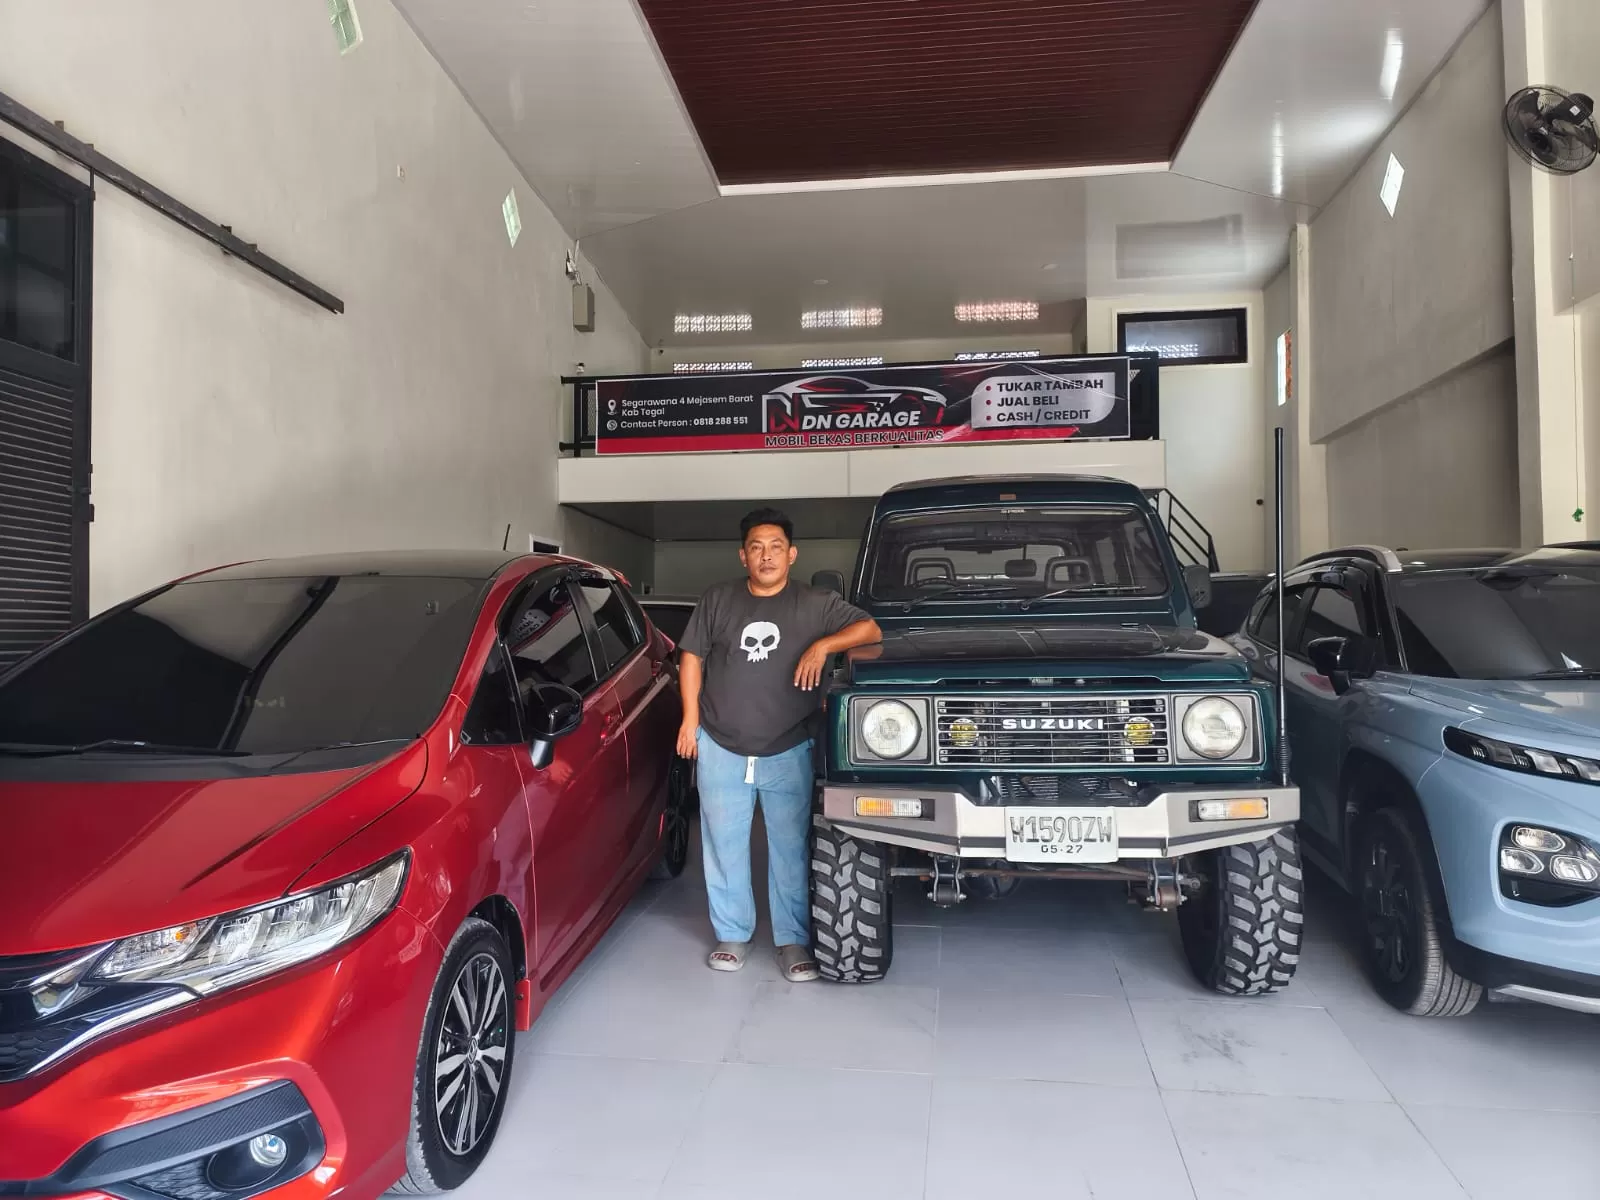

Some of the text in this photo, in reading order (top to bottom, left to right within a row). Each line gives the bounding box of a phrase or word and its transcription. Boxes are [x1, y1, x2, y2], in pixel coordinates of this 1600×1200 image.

[997, 379, 1103, 392] TUKAR TAMBAH
[621, 399, 678, 408] Segarawana
[679, 397, 685, 405] 4
[728, 394, 754, 403] Barat
[997, 395, 1059, 407] JUAL BELI
[621, 407, 665, 417] Kab Tegal
[996, 408, 1091, 423] CASH / CREDIT
[620, 419, 656, 429] Contact
[657, 419, 688, 428] Person
[693, 418, 714, 426] 0818
[715, 416, 732, 425] 288
[733, 416, 748, 424] 551
[801, 410, 921, 430] DN GARAGE
[765, 429, 944, 447] MOBIL BEKAS BERKUALITAS
[1002, 718, 1104, 730] SUZUKI
